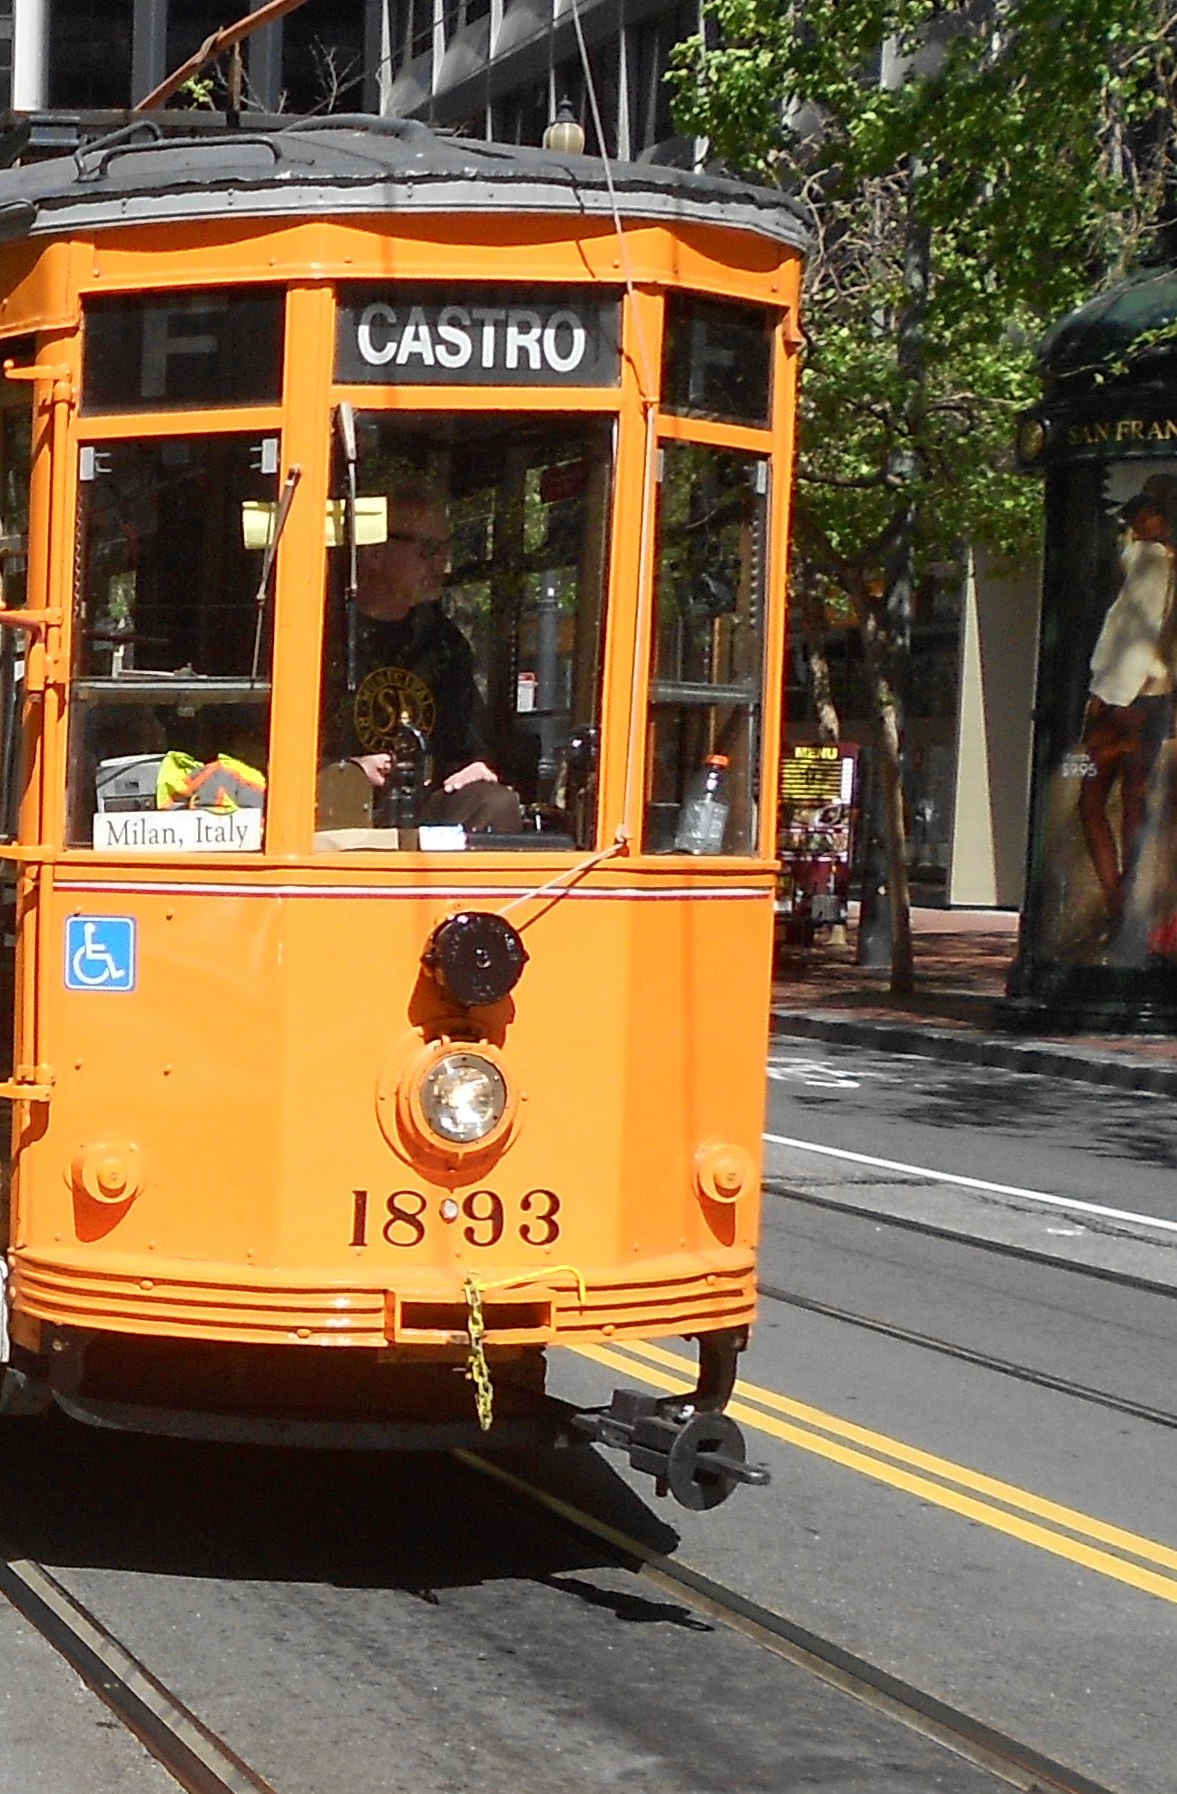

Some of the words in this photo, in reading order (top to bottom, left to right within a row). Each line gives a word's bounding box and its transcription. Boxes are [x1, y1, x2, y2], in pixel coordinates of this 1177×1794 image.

[142, 296, 229, 398] F
[357, 302, 586, 373] CASTRO
[1069, 423, 1111, 444] SAN
[795, 746, 839, 760] MENU
[106, 818, 184, 847] Milan,
[195, 815, 248, 848] Italy
[348, 1188, 562, 1248] 1893
